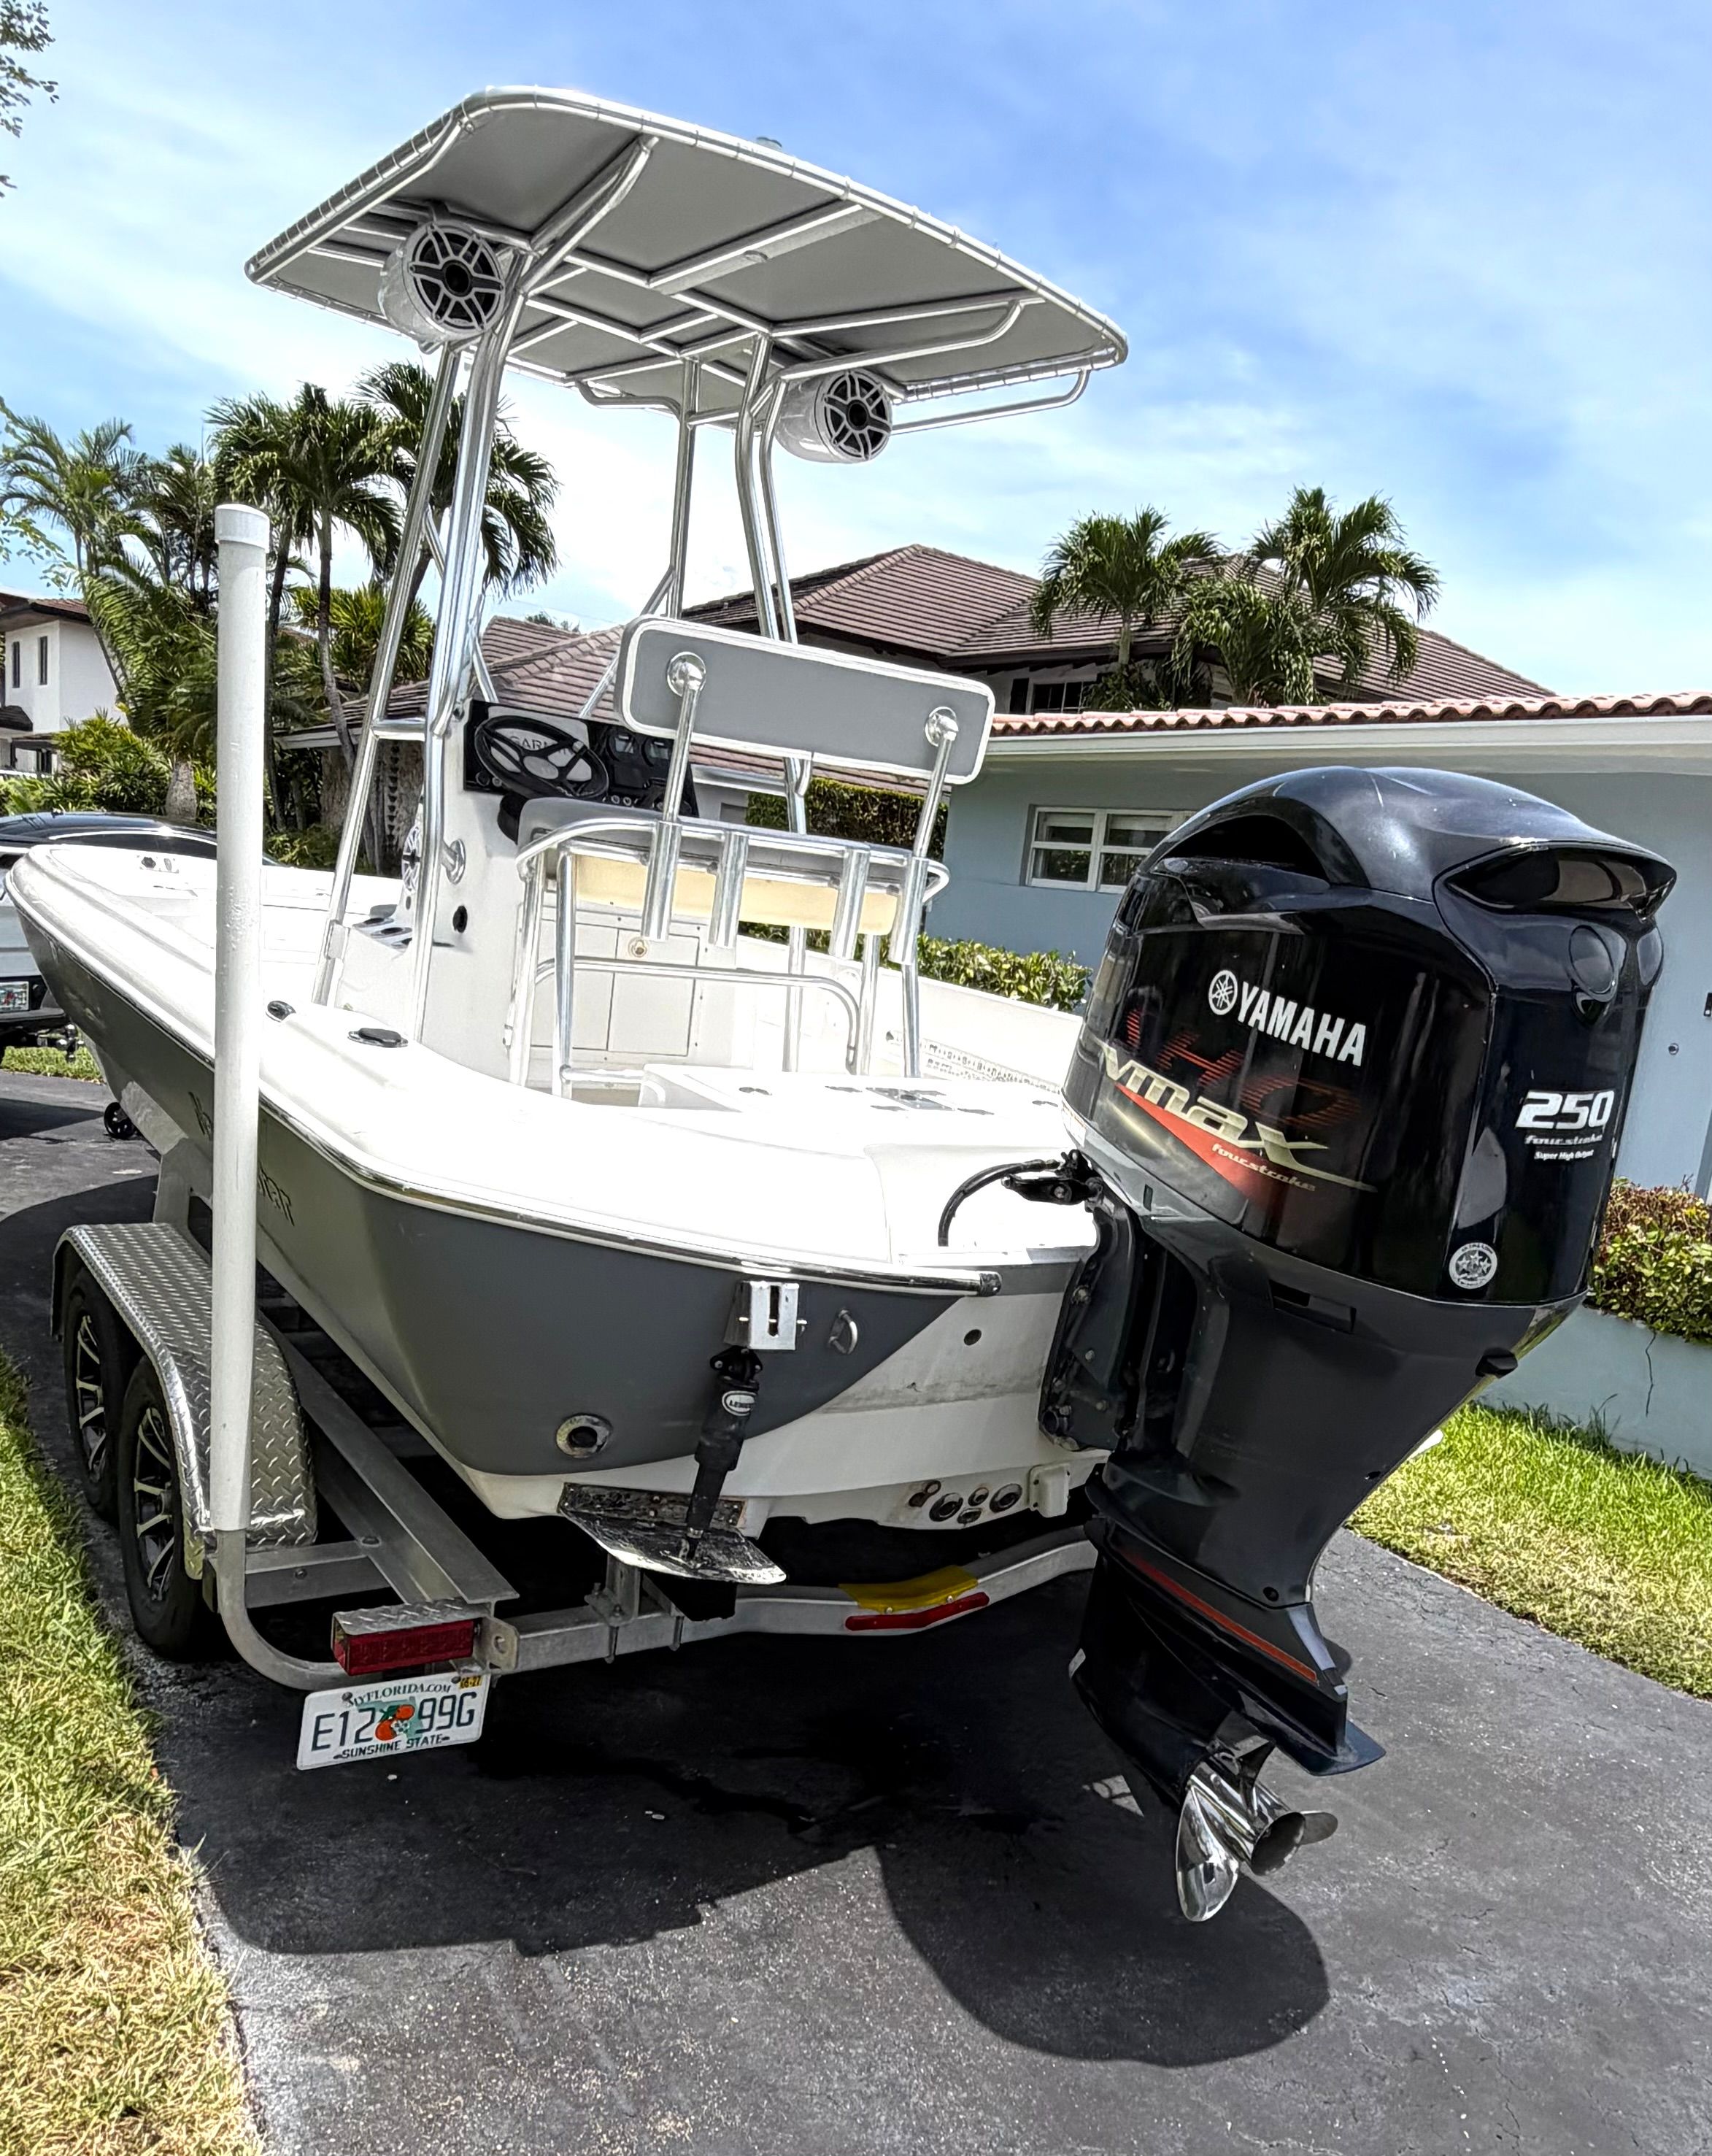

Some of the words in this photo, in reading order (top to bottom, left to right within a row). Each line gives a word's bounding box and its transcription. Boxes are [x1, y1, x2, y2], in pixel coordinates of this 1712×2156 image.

[1237, 981, 1367, 1067] YAMAHA
[1514, 1090, 1615, 1130] 250
[311, 1706, 375, 1752] E12
[414, 1691, 477, 1734] 99G
[342, 1741, 401, 1760] SUNSHINE
[406, 1733, 442, 1748] STATE
